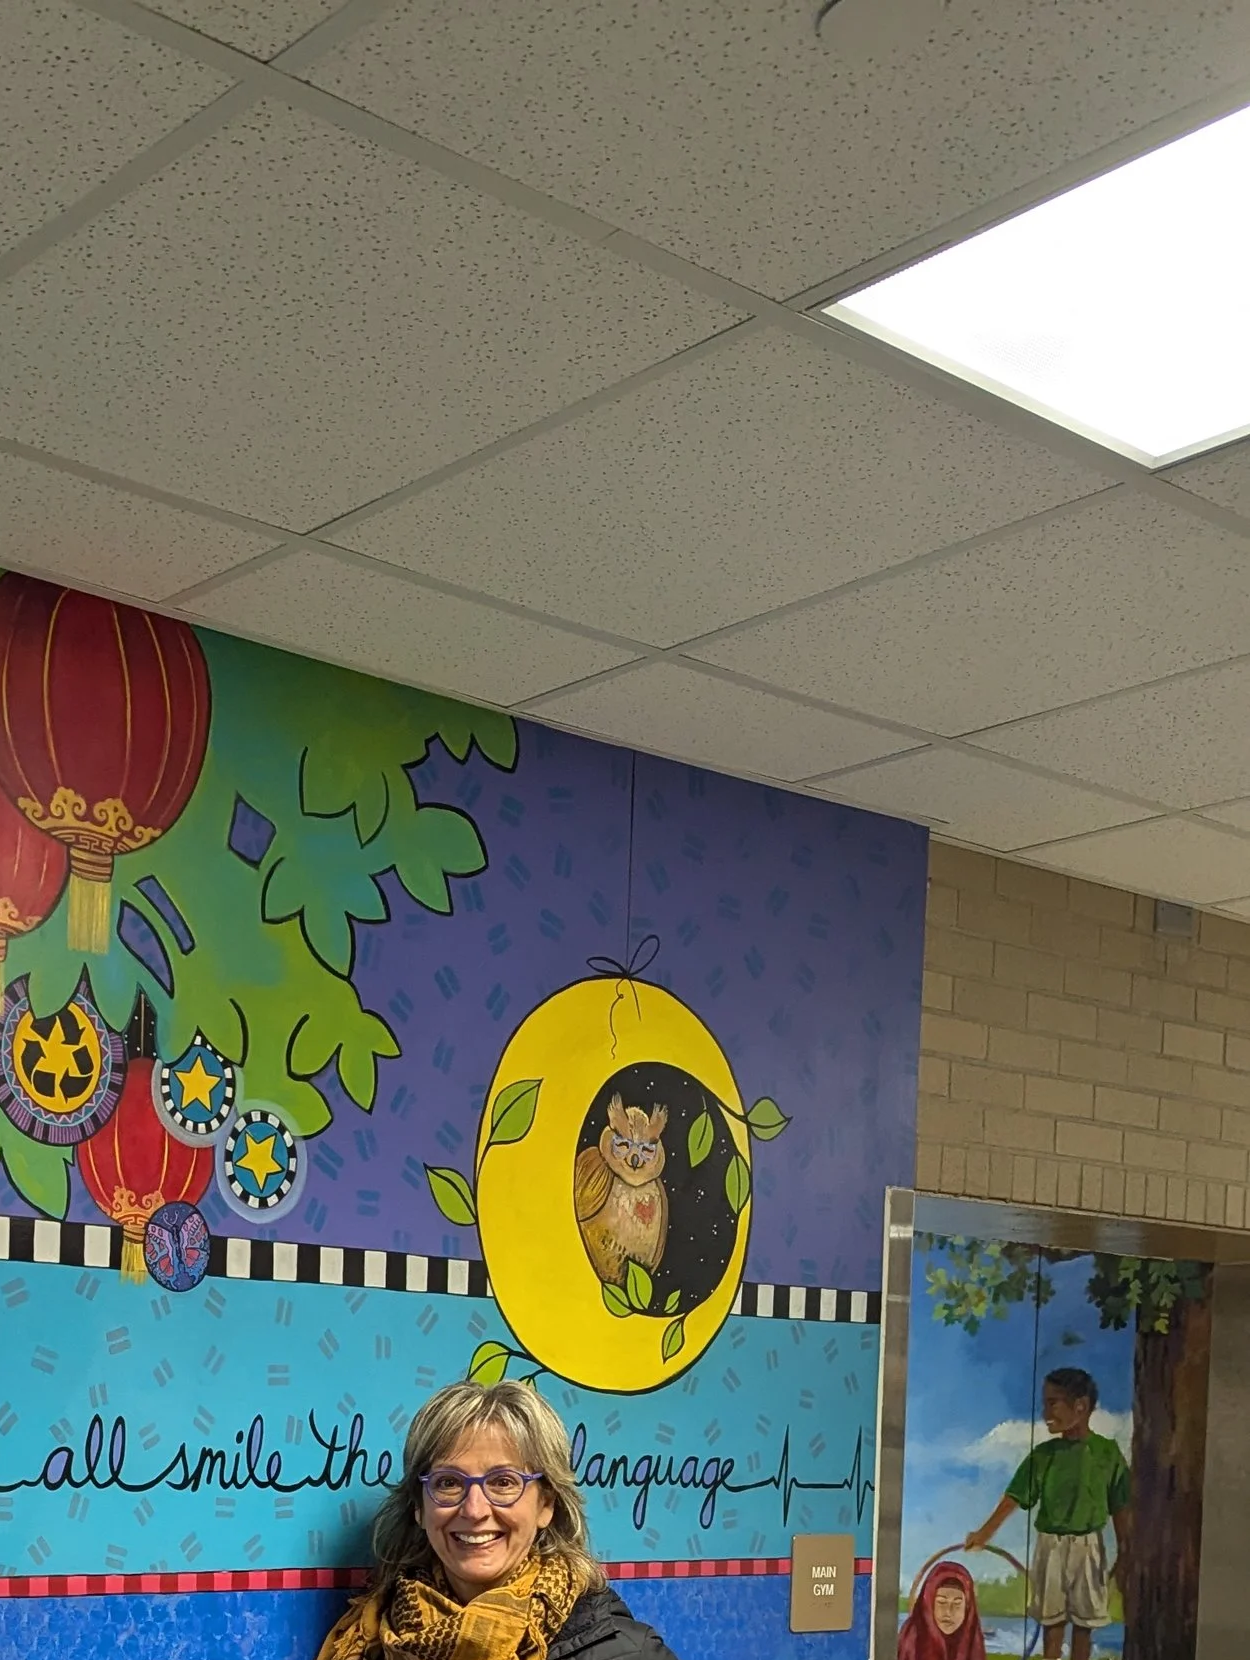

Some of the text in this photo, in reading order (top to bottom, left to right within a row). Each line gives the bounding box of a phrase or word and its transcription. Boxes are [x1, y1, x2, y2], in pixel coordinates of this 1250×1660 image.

[42, 1413, 144, 1493] all
[166, 1412, 300, 1494] smile
[307, 1407, 400, 1490] the
[569, 1421, 740, 1531] language
[811, 1566, 837, 1578] MAIN
[813, 1583, 835, 1596] GYM
